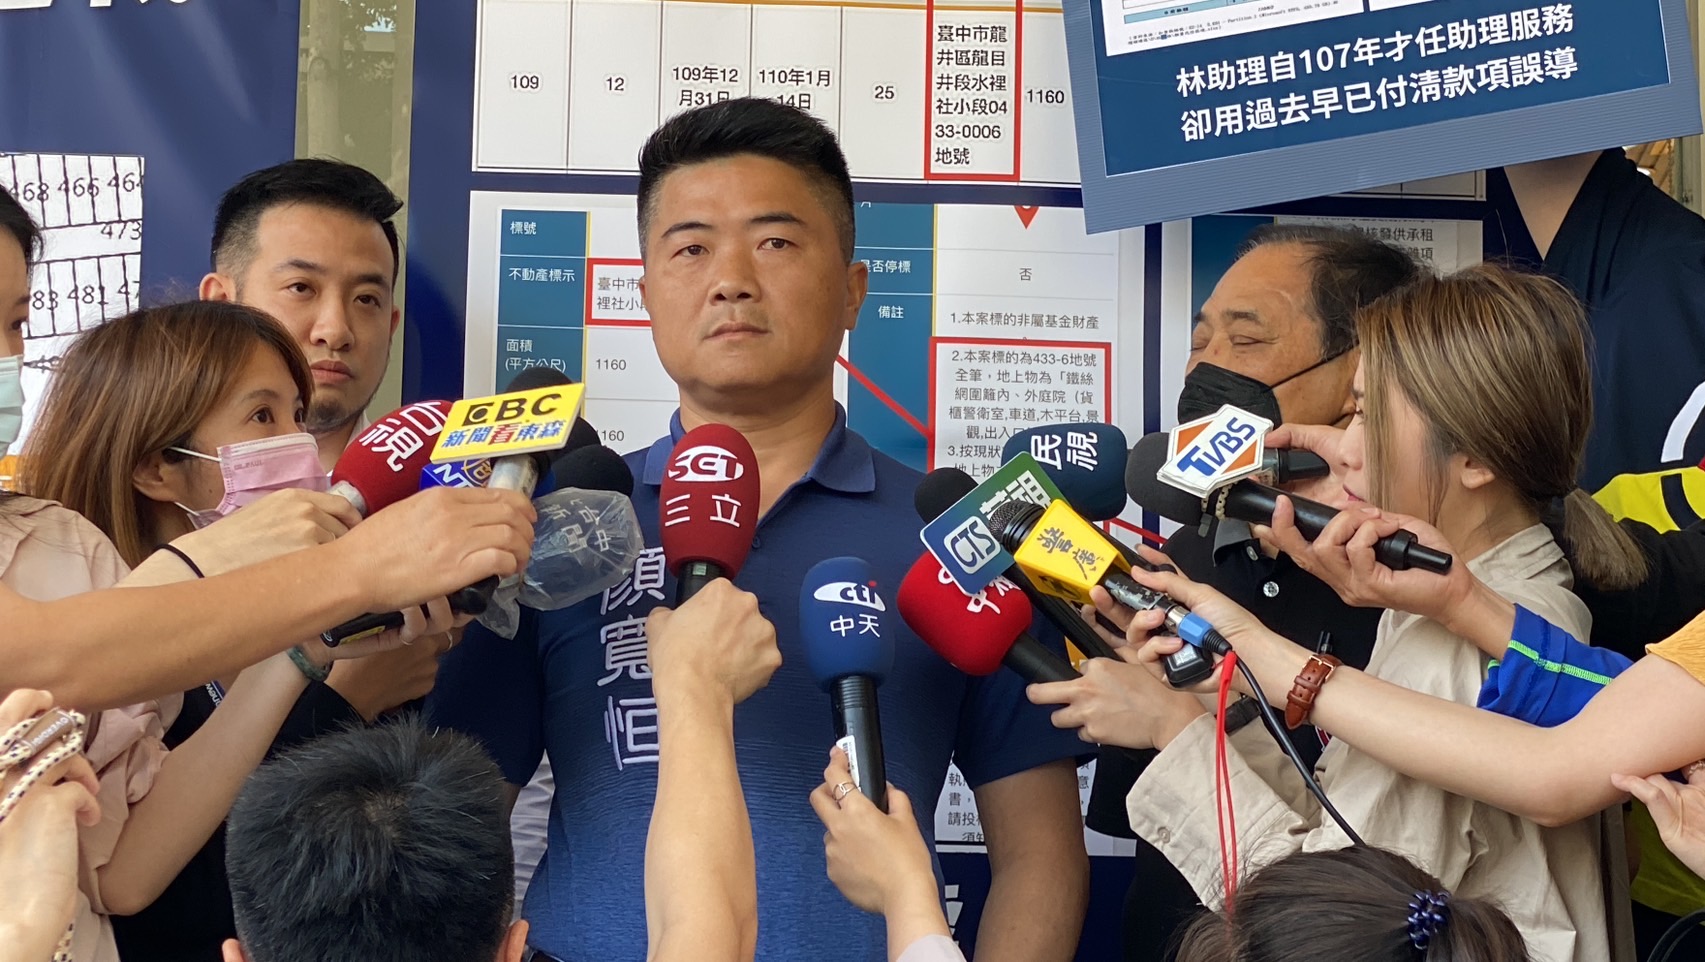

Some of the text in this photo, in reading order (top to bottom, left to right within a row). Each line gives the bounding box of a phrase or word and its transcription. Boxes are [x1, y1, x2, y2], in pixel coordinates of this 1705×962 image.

[938, 25, 1008, 43] 臺中市龍
[936, 49, 1005, 67] 井區龍目
[1176, 3, 1575, 98] 林助理自107年才任助理服務
[510, 75, 539, 90] 109
[673, 66, 738, 84] 109年12
[759, 69, 830, 87] 110年1月
[936, 74, 1007, 92] 井段水裡
[606, 77, 625, 92] 12
[875, 86, 895, 100] 25
[1027, 90, 1065, 104] 1160
[1180, 46, 1579, 142] 卻用過去早已付清款項誤導
[935, 98, 1008, 116] 社小段04
[935, 125, 1001, 139] 33-0006
[935, 148, 970, 165] 地號
[510, 221, 537, 235] 標號
[508, 267, 576, 282] 不動產標示
[1019, 268, 1033, 281] 否
[597, 296, 645, 311] 裡社小
[878, 305, 904, 319] 備註
[950, 311, 1100, 329] 1.本案標的非屬基金財產
[506, 338, 533, 353] 面積
[596, 359, 627, 371] 1160
[951, 349, 1098, 368] 2.本案標的為433-6地號
[462, 394, 562, 426] EBC
[598, 430, 625, 442] 160
[1031, 431, 1098, 471] 民視
[1177, 416, 1257, 477] TVBS
[665, 493, 742, 527] 三立
[950, 520, 996, 568] CTS
[830, 614, 880, 637] 中天
[948, 773, 967, 786] 執
